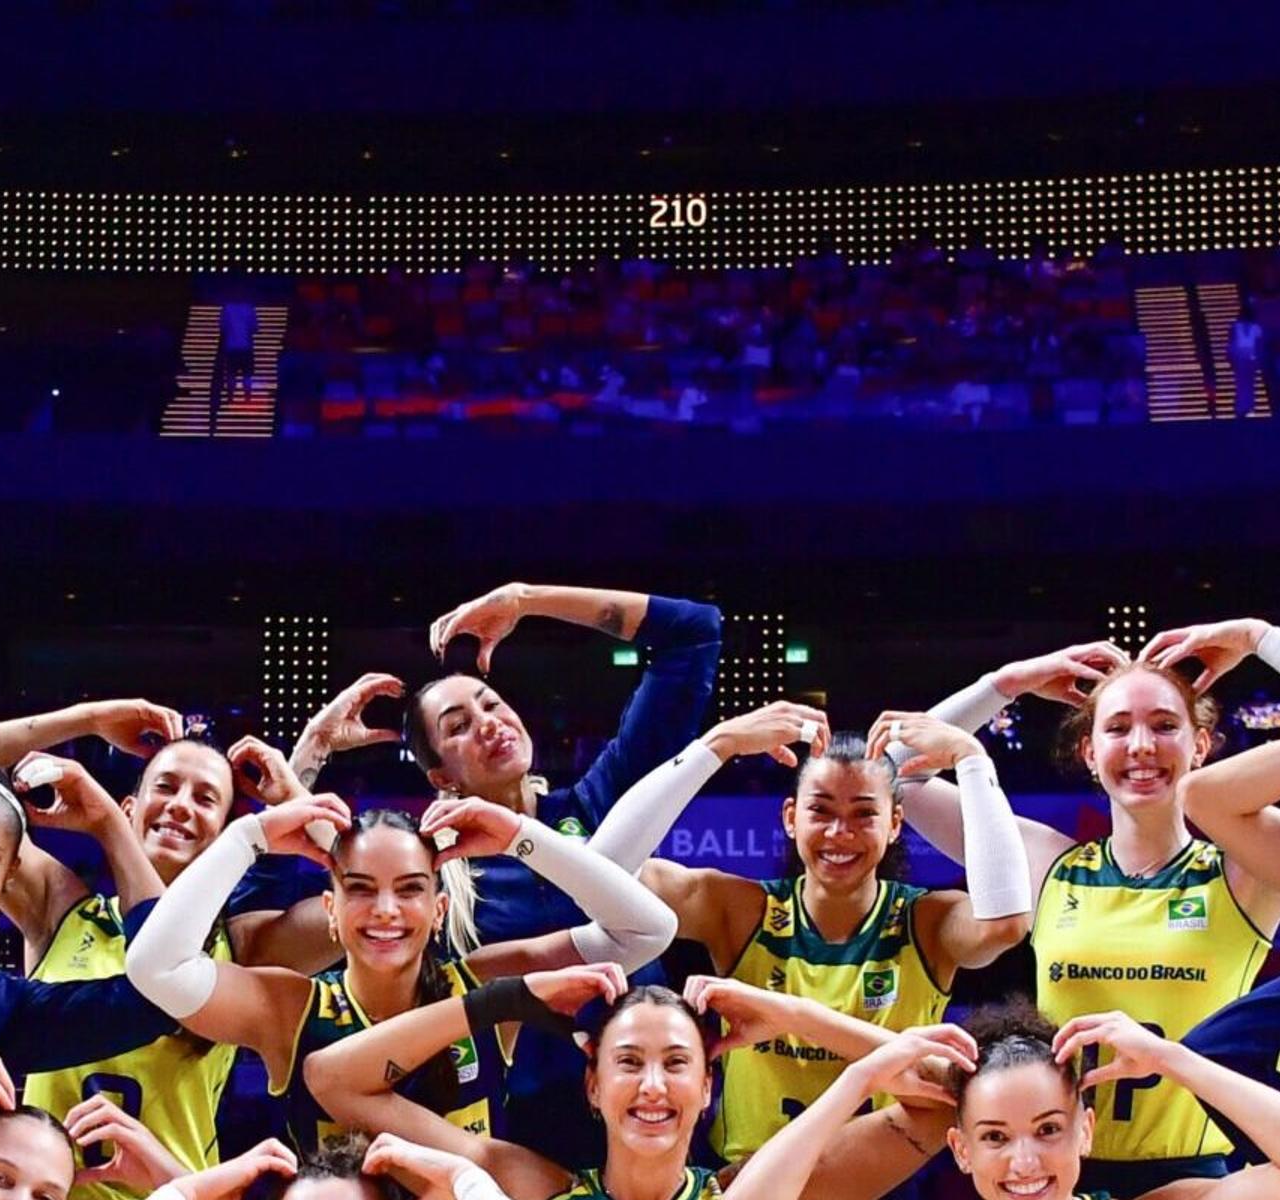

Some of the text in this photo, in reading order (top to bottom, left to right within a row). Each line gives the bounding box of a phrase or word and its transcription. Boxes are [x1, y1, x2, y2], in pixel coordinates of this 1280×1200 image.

[649, 199, 707, 229] 210
[656, 828, 765, 858] BALL
[1067, 963, 1208, 982] BANCO DO BRASIL
[774, 1040, 826, 1062] BANCO
